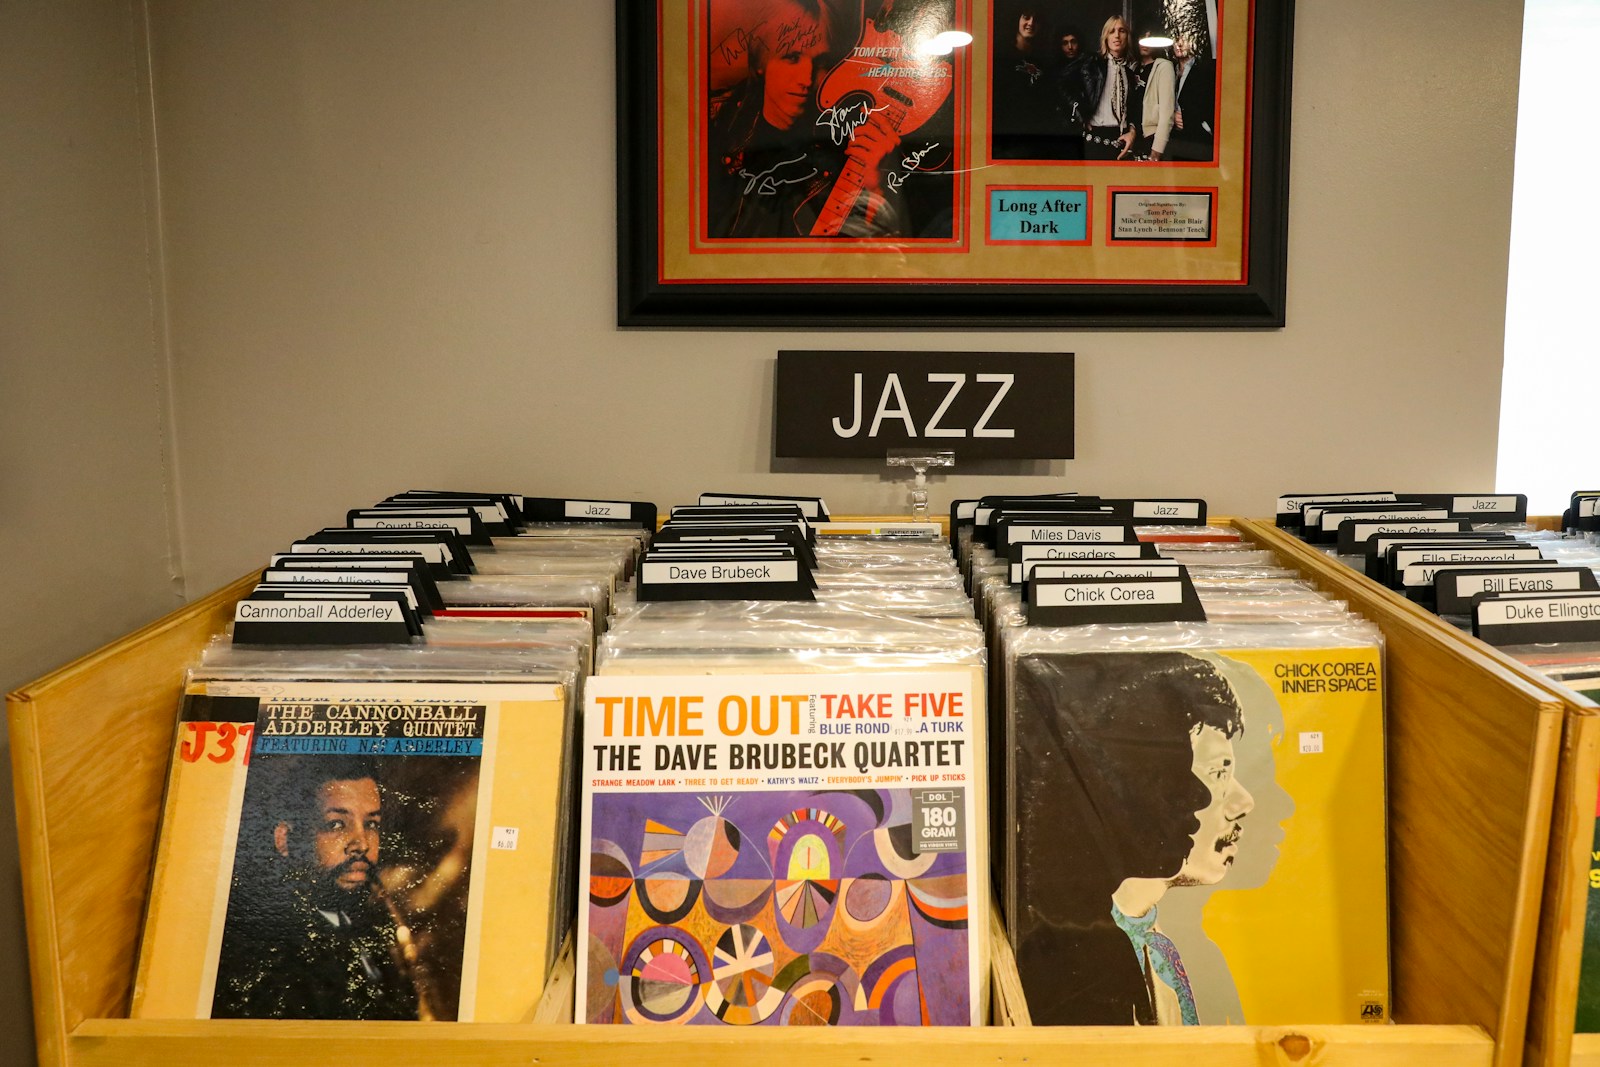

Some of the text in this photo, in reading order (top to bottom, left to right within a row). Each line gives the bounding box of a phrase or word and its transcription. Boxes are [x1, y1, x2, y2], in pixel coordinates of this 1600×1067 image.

[853, 46, 876, 58] TOM
[875, 46, 909, 59] PETT
[998, 198, 1082, 214] Long After
[1020, 220, 1060, 234] Dark
[1134, 226, 1153, 234] Lynch
[832, 372, 1015, 439] JAZZ
[584, 503, 610, 517] Jazz
[1152, 504, 1179, 517] Jazz
[1472, 499, 1497, 511] Jazz
[1030, 528, 1101, 541] Miles Davis
[1047, 548, 1116, 559] Crusaders
[669, 565, 771, 580] Dave Brubeck
[1483, 577, 1553, 592] Bill Evans
[1064, 586, 1155, 602] Chick Corea
[239, 604, 393, 622] Cannonball Adderley
[1505, 603, 1544, 620] Duke
[1274, 662, 1377, 678] CHICK COREA
[1282, 678, 1377, 694] INNER SPACE
[267, 704, 478, 721] THE CANNONBALL
[820, 692, 964, 719] TAKE FIVE
[595, 694, 809, 736] TIME OUT
[808, 694, 817, 734] Featuring
[262, 720, 476, 738] ADDERLEY QUINTET
[820, 723, 851, 735] BLUE
[855, 722, 892, 734] ROND
[930, 721, 964, 733] TURK
[260, 737, 474, 755] FEATURING NAT ADDERLEY
[593, 740, 965, 774] THE DAVE BRUBECK QUARTET
[592, 779, 623, 787] STRANGE
[685, 778, 706, 786] THREE
[737, 777, 759, 785] READY
[767, 777, 796, 785] KATHY'S
[798, 776, 819, 784] WALTZ
[827, 775, 872, 784] EVERYBODY'S
[875, 775, 903, 783] JUMPIN'
[911, 774, 927, 782] PICK
[930, 774, 939, 782] UP
[942, 773, 966, 781] STICKS
[929, 793, 947, 801] DOL
[921, 806, 957, 827] 180
[921, 826, 956, 838] GRAM
